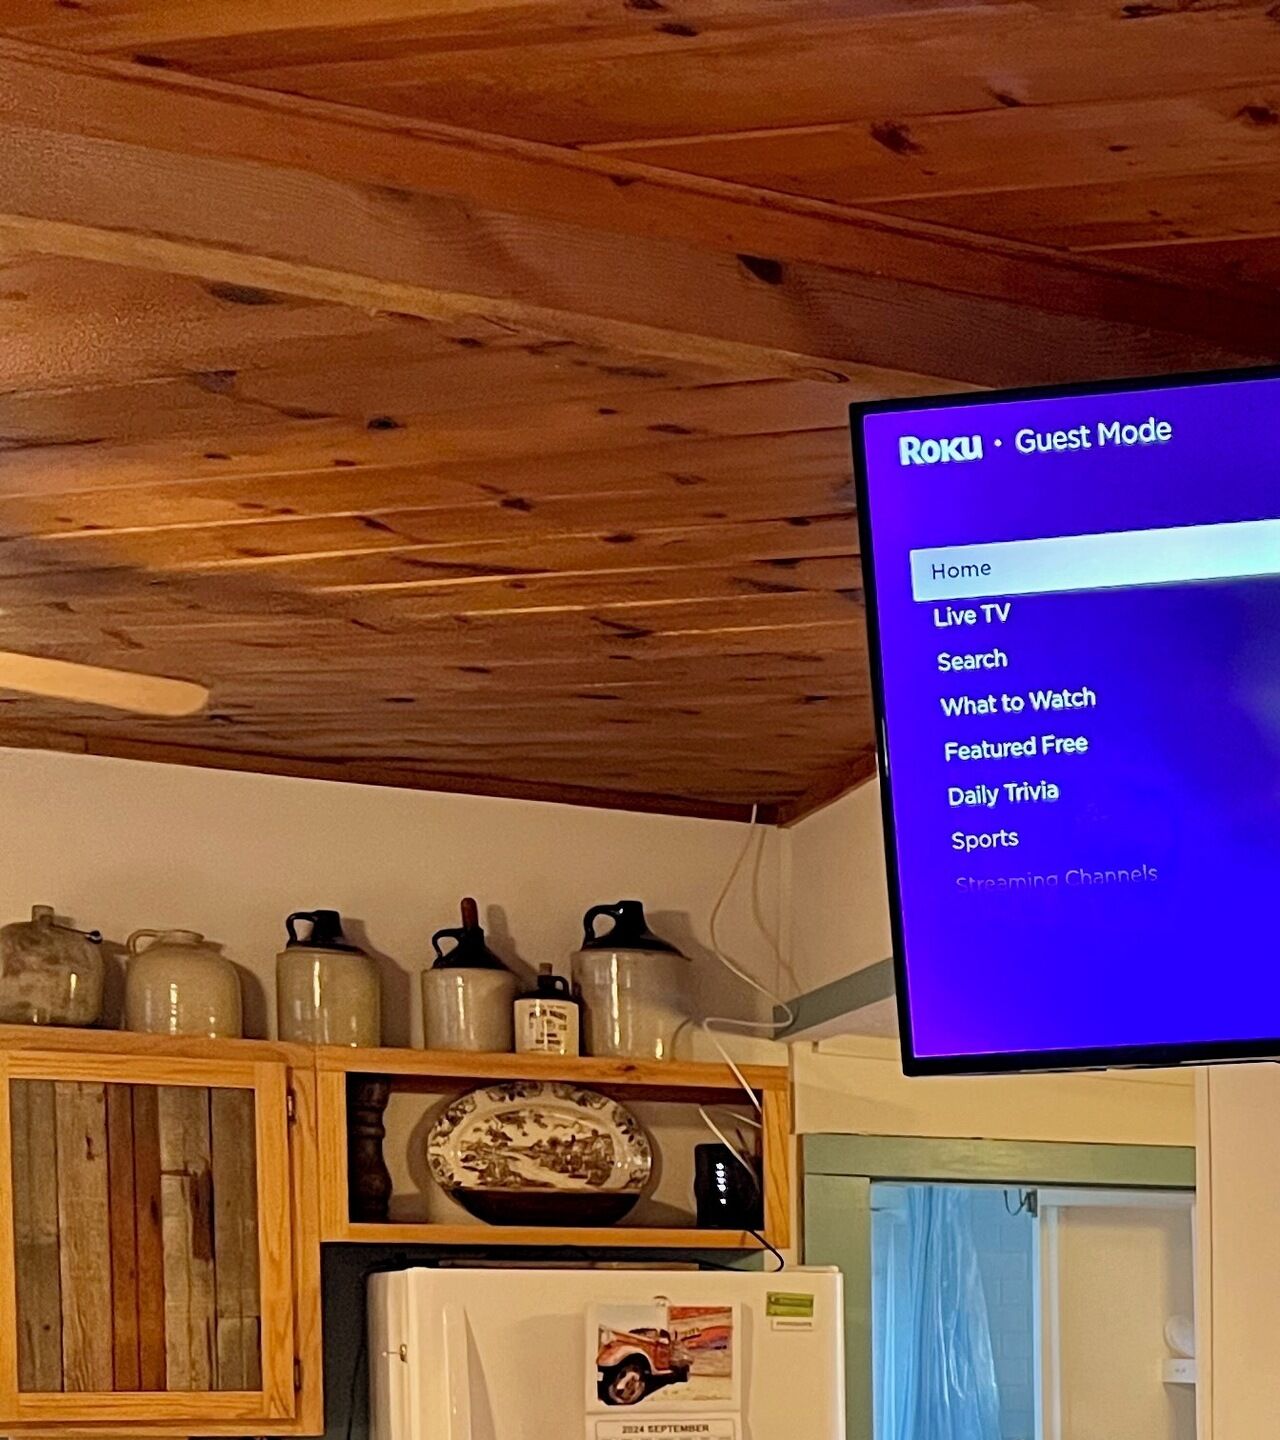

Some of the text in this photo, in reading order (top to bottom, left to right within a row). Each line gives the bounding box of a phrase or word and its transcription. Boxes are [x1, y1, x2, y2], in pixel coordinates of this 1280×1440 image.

[899, 416, 1172, 466] Roku Guest Mode
[931, 562, 992, 580] Home
[933, 602, 1011, 628] Live TV
[937, 648, 1009, 672] Search
[940, 686, 1097, 717] What to Watch
[944, 733, 1089, 763] Featured Free
[947, 780, 1060, 808] Daily Trivia
[951, 829, 1020, 853] Sports
[955, 863, 1159, 894] Streaming Channels
[621, 1423, 710, 1434] 2024 SEPTEMBER
